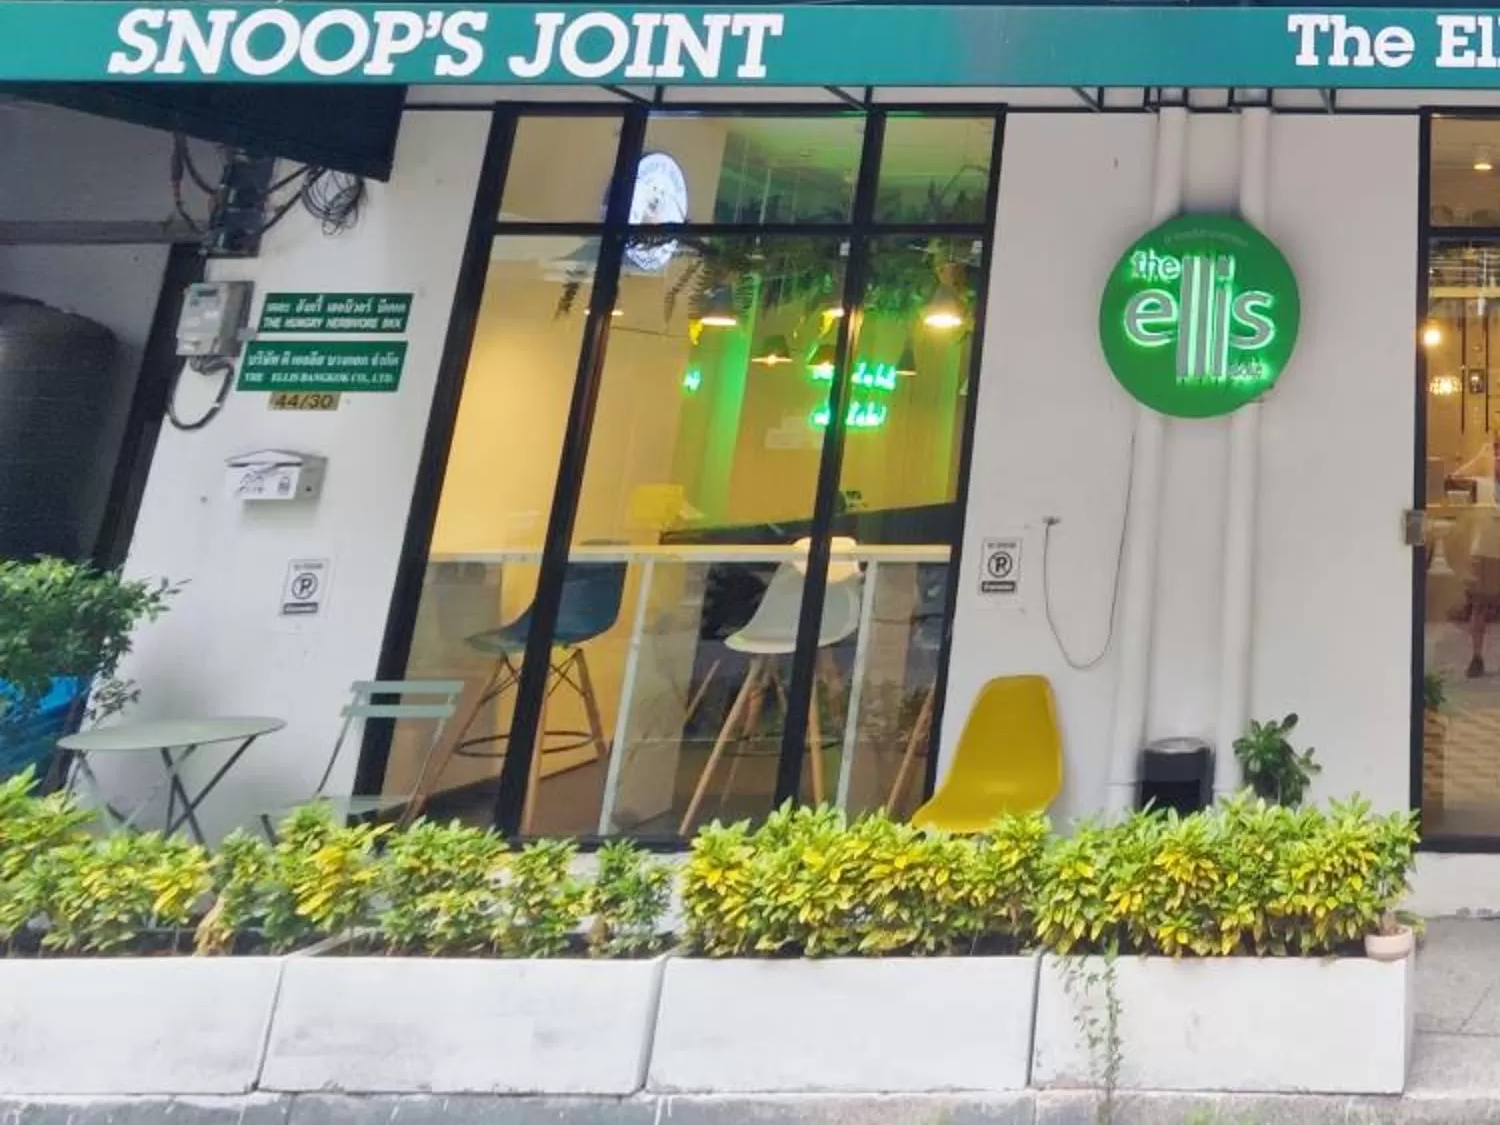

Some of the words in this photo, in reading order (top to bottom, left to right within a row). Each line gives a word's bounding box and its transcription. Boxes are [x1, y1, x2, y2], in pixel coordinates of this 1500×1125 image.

[107, 8, 488, 76] SNOOP'S
[508, 12, 785, 78] JOINT
[1288, 14, 1415, 68] The
[1130, 249, 1182, 279] the
[1124, 254, 1275, 384] ellis
[275, 394, 334, 409] 44/30
